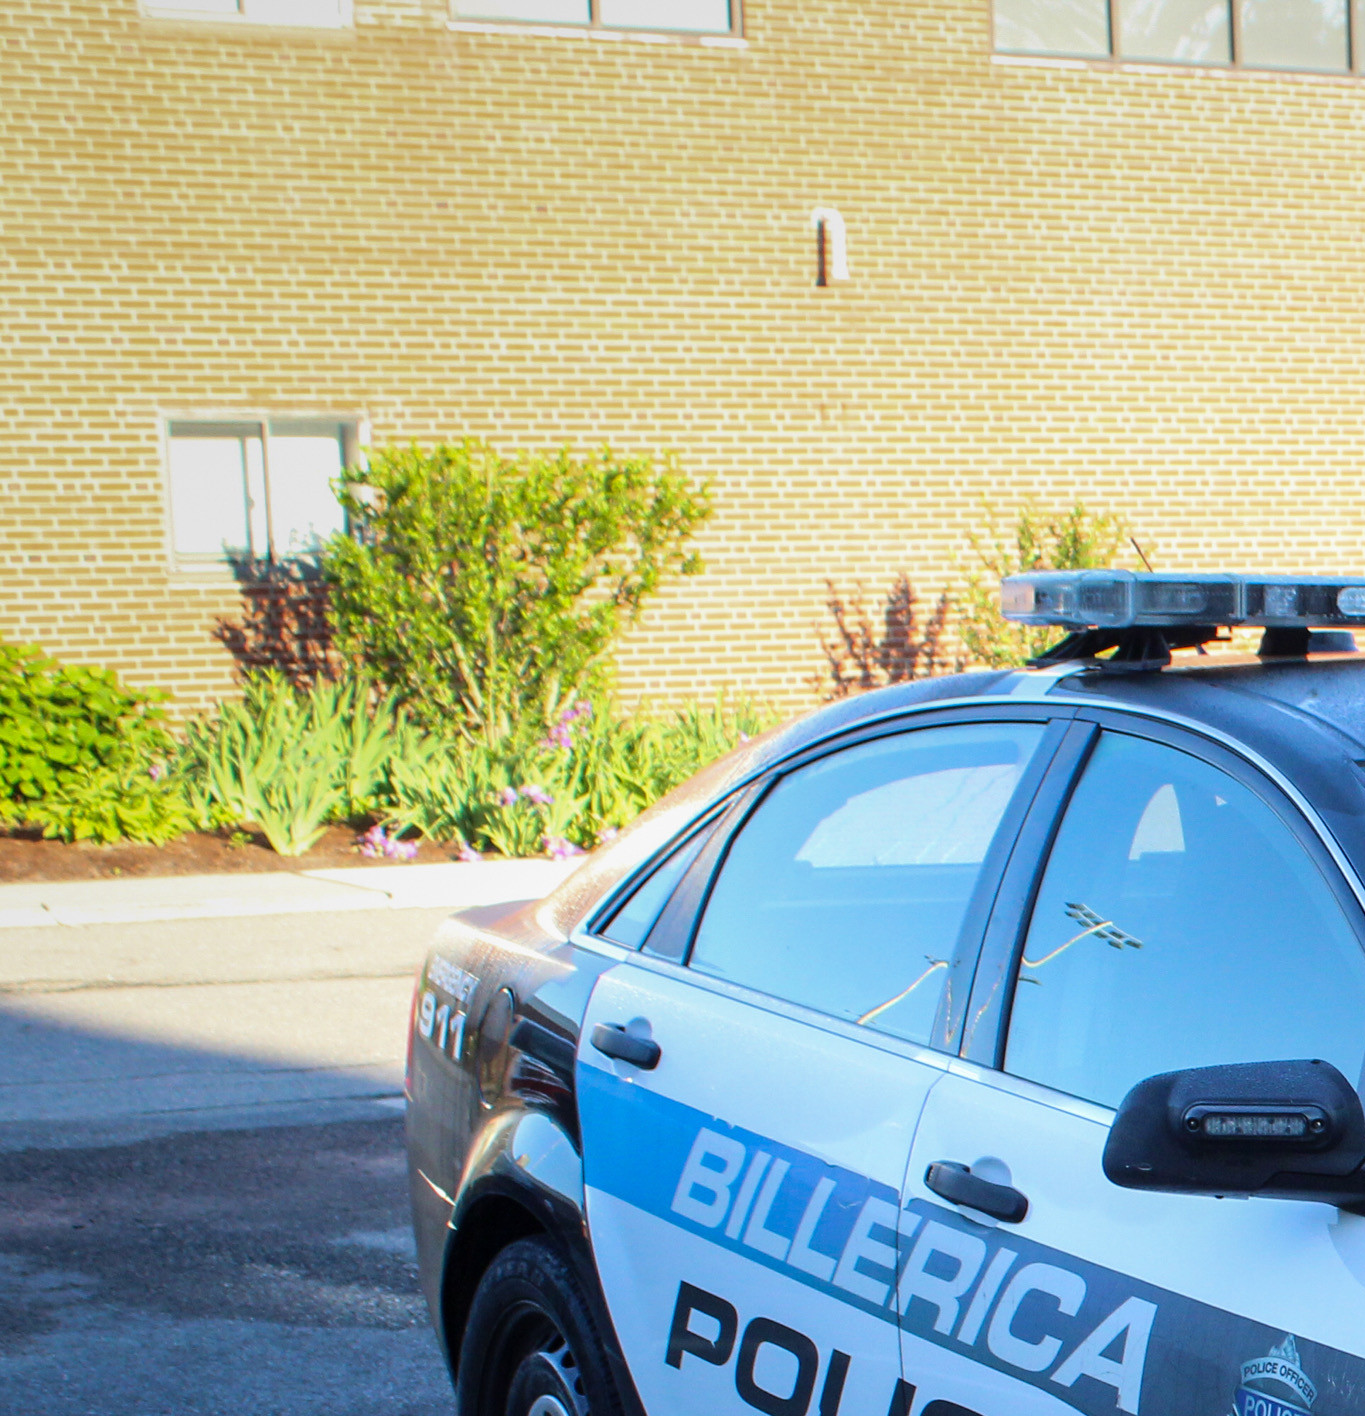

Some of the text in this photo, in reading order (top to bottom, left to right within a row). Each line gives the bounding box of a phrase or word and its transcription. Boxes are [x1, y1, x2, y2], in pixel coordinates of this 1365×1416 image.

[418, 992, 467, 1062] 911
[670, 1127, 1158, 1416] BILLERICA
[1243, 1361, 1315, 1400] POLICE OFFICER
